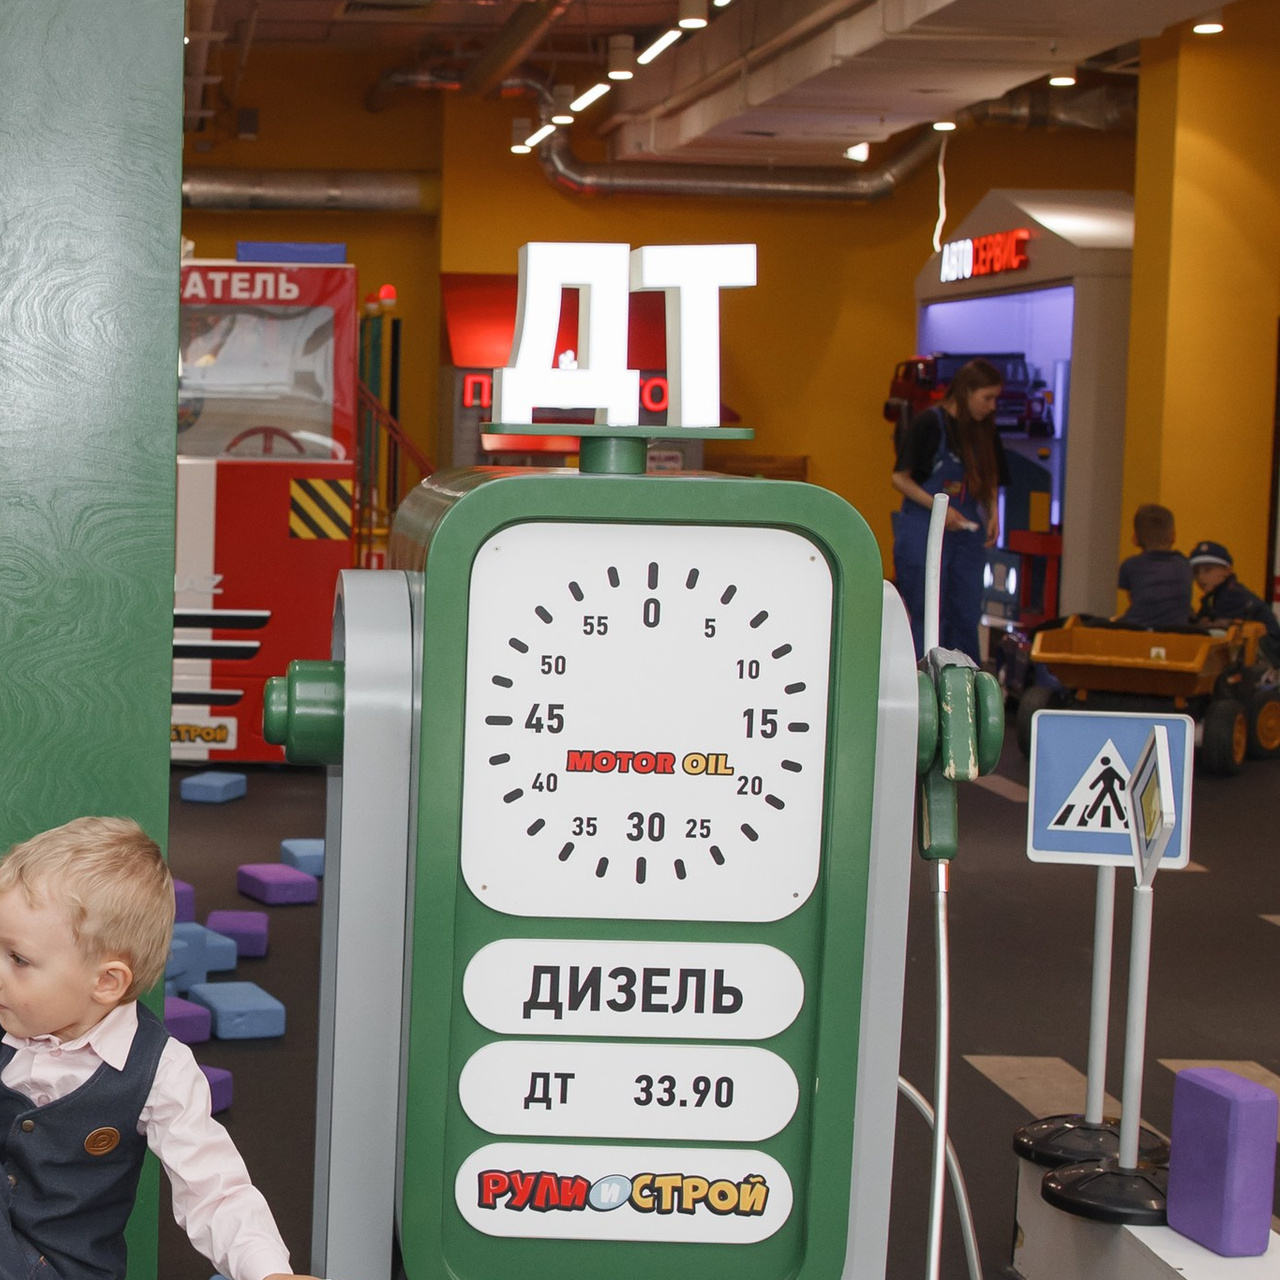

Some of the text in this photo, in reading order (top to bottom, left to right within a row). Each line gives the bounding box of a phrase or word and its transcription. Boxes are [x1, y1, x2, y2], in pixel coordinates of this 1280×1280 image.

[181, 271, 300, 301] АТЕЛЬ
[491, 241, 757, 427] ДТ
[582, 615, 609, 636] 55
[643, 597, 661, 629] 0
[704, 618, 716, 639] 5
[540, 654, 567, 676] 50
[736, 659, 760, 680] 10
[524, 703, 565, 734] 45
[742, 708, 778, 739] 15
[566, 749, 735, 777] MOTOR OIL
[531, 772, 558, 793] 40
[736, 775, 763, 796] 20
[571, 816, 598, 837] 35
[626, 811, 666, 843] 30
[685, 818, 711, 839] 25
[522, 964, 744, 1020] ДИЗЕЛЬ
[523, 1071, 734, 1111] ДТ 33.90
